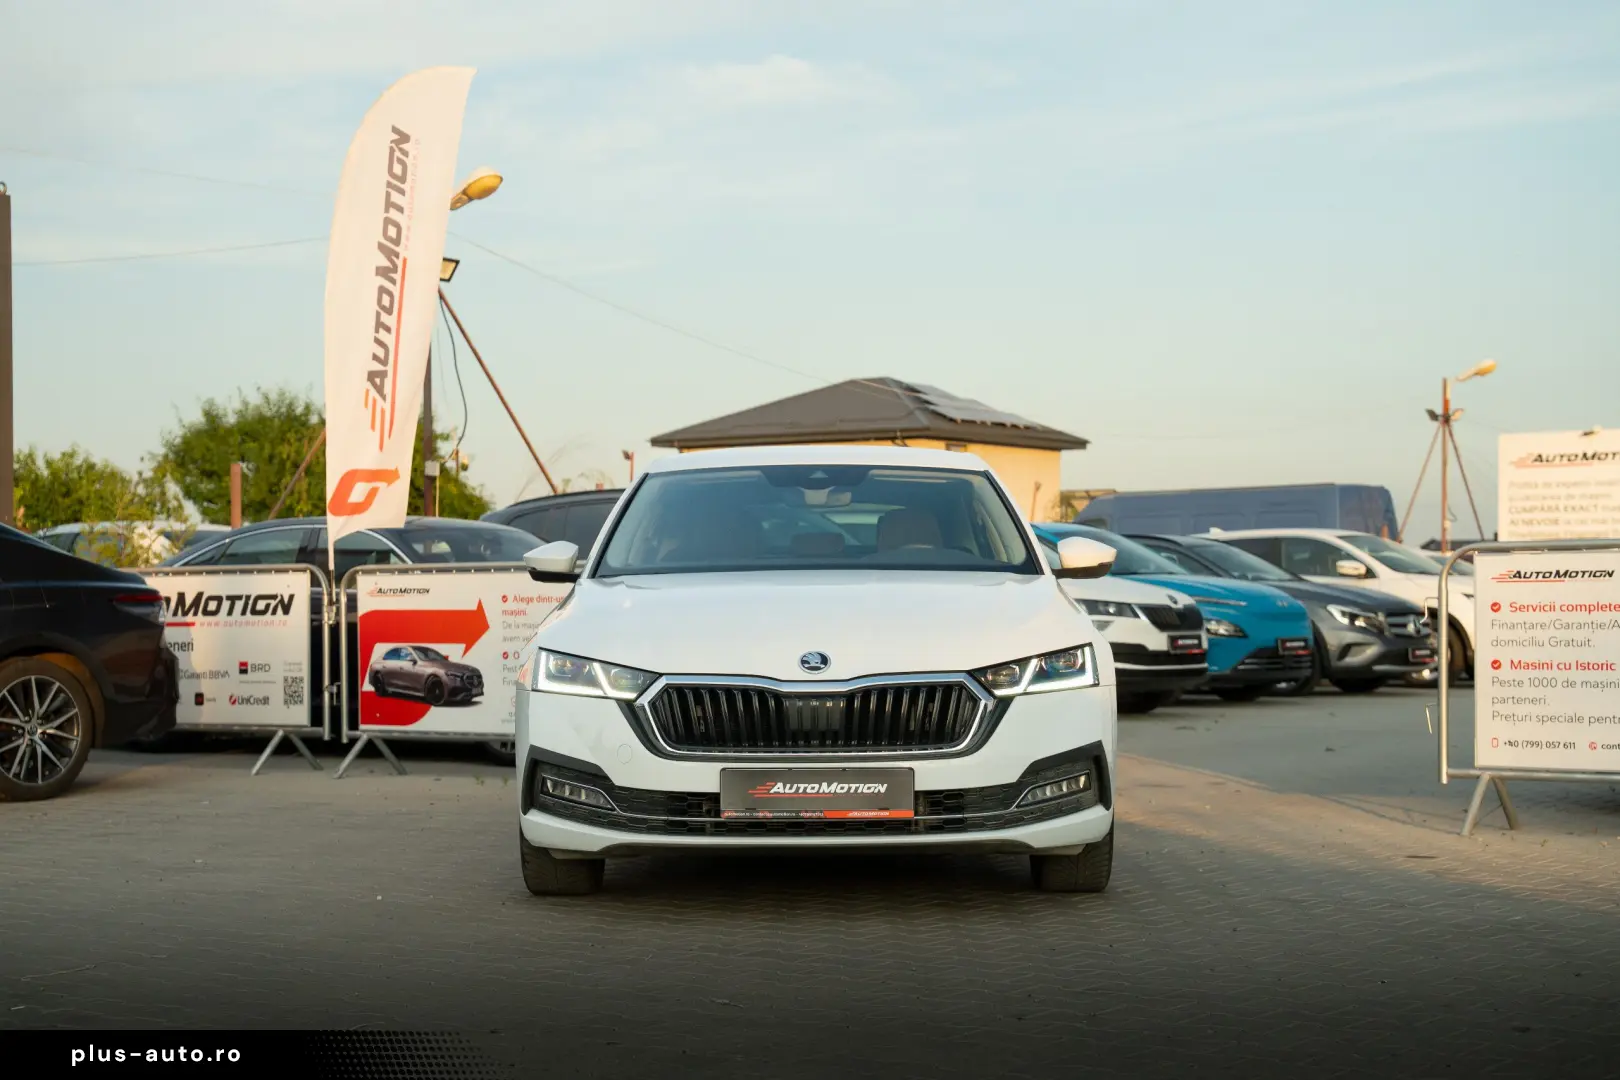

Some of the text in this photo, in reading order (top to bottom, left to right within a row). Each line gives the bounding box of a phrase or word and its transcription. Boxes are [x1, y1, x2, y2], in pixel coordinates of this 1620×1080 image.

[512, 594, 534, 605] Alege
[1509, 601, 1620, 615] Servicii complete
[1491, 635, 1596, 649] domiciliu Gratuit.
[250, 663, 271, 673] BRD
[1510, 659, 1617, 671] Masini cu Istoric
[1491, 676, 1525, 688] Peste
[1527, 677, 1558, 689] 1000
[1561, 678, 1577, 689] de
[237, 694, 270, 705] UniCredit
[1535, 713, 1585, 726] speciale
[1521, 739, 1543, 749] (799)
[1545, 741, 1561, 749] 057
[1563, 742, 1576, 750] 611
